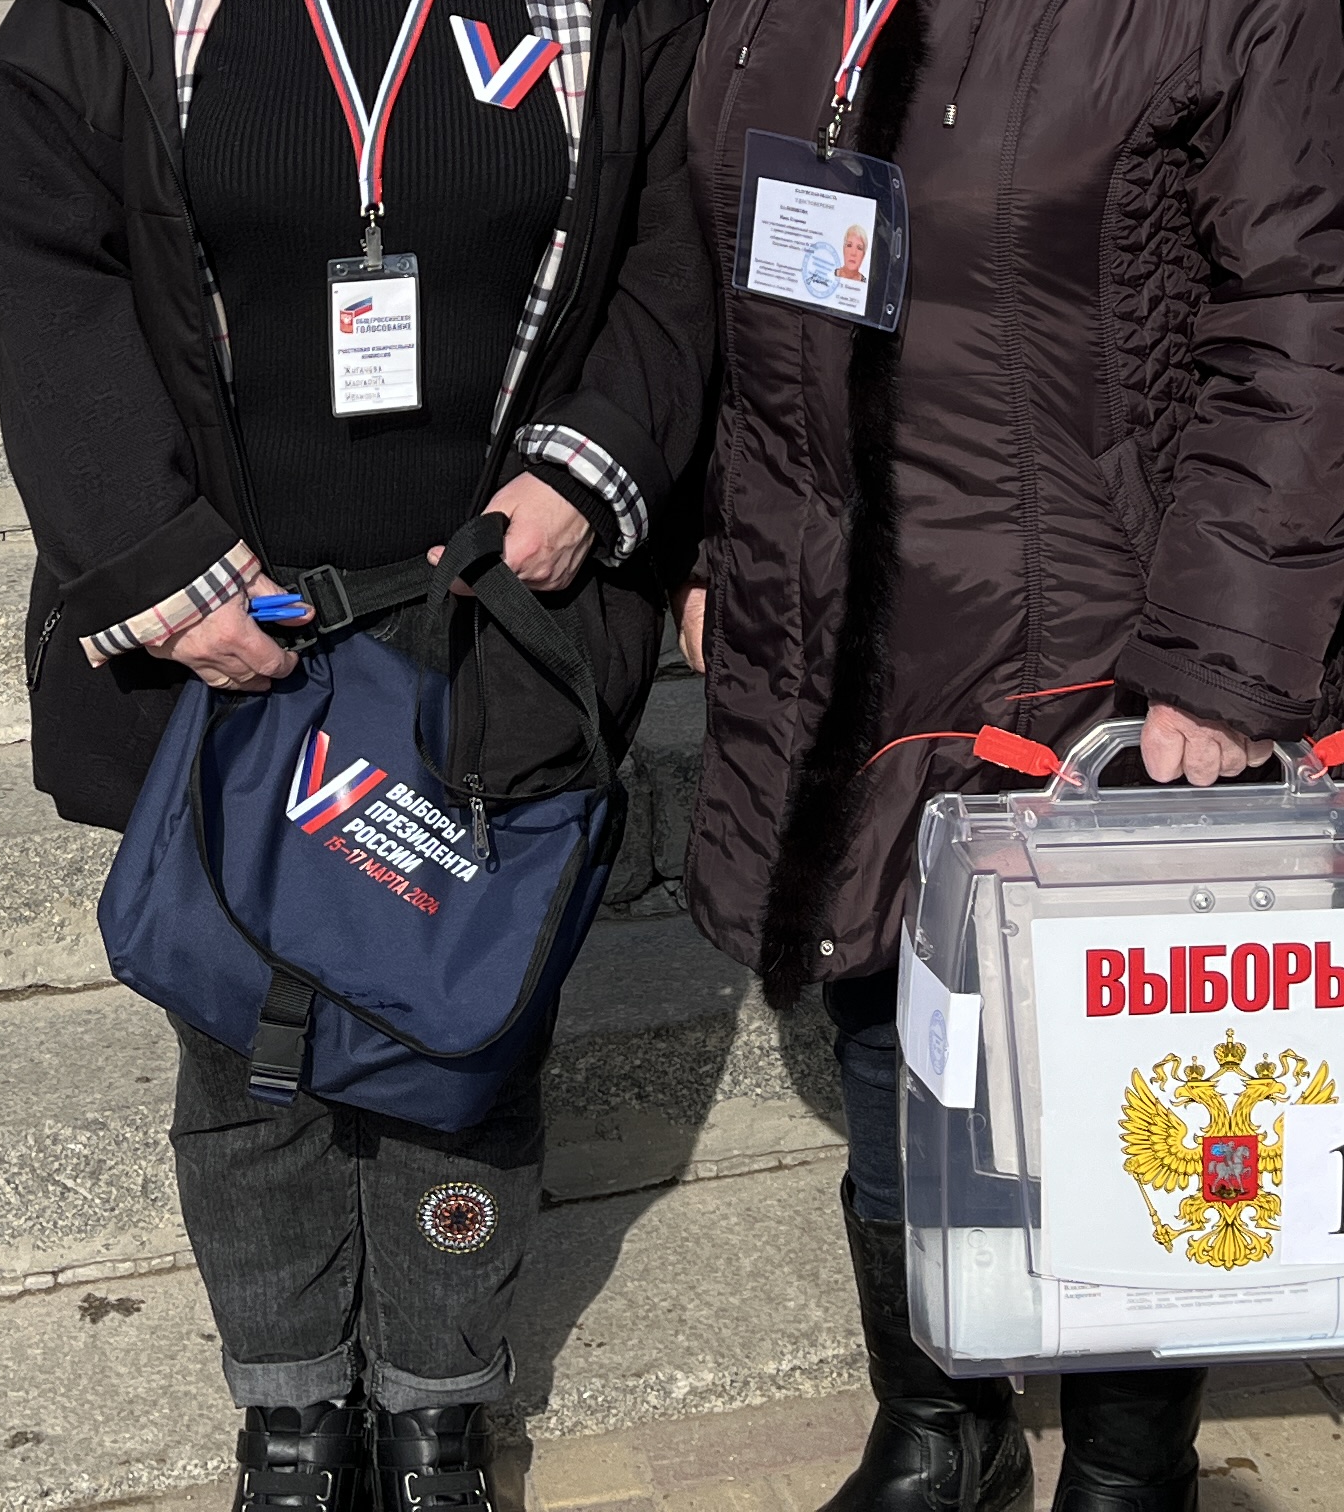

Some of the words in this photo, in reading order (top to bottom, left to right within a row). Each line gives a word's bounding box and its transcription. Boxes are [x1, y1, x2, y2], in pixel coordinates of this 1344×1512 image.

[356, 322, 411, 334] ГОЛОСОВАНИЕ
[364, 800, 479, 883] ПРЕЗИДЕНТА
[385, 782, 467, 844] ВЫБОРЫ
[341, 817, 424, 874] РОССИИ
[358, 857, 410, 896] МАРТА
[402, 886, 441, 916] 2024
